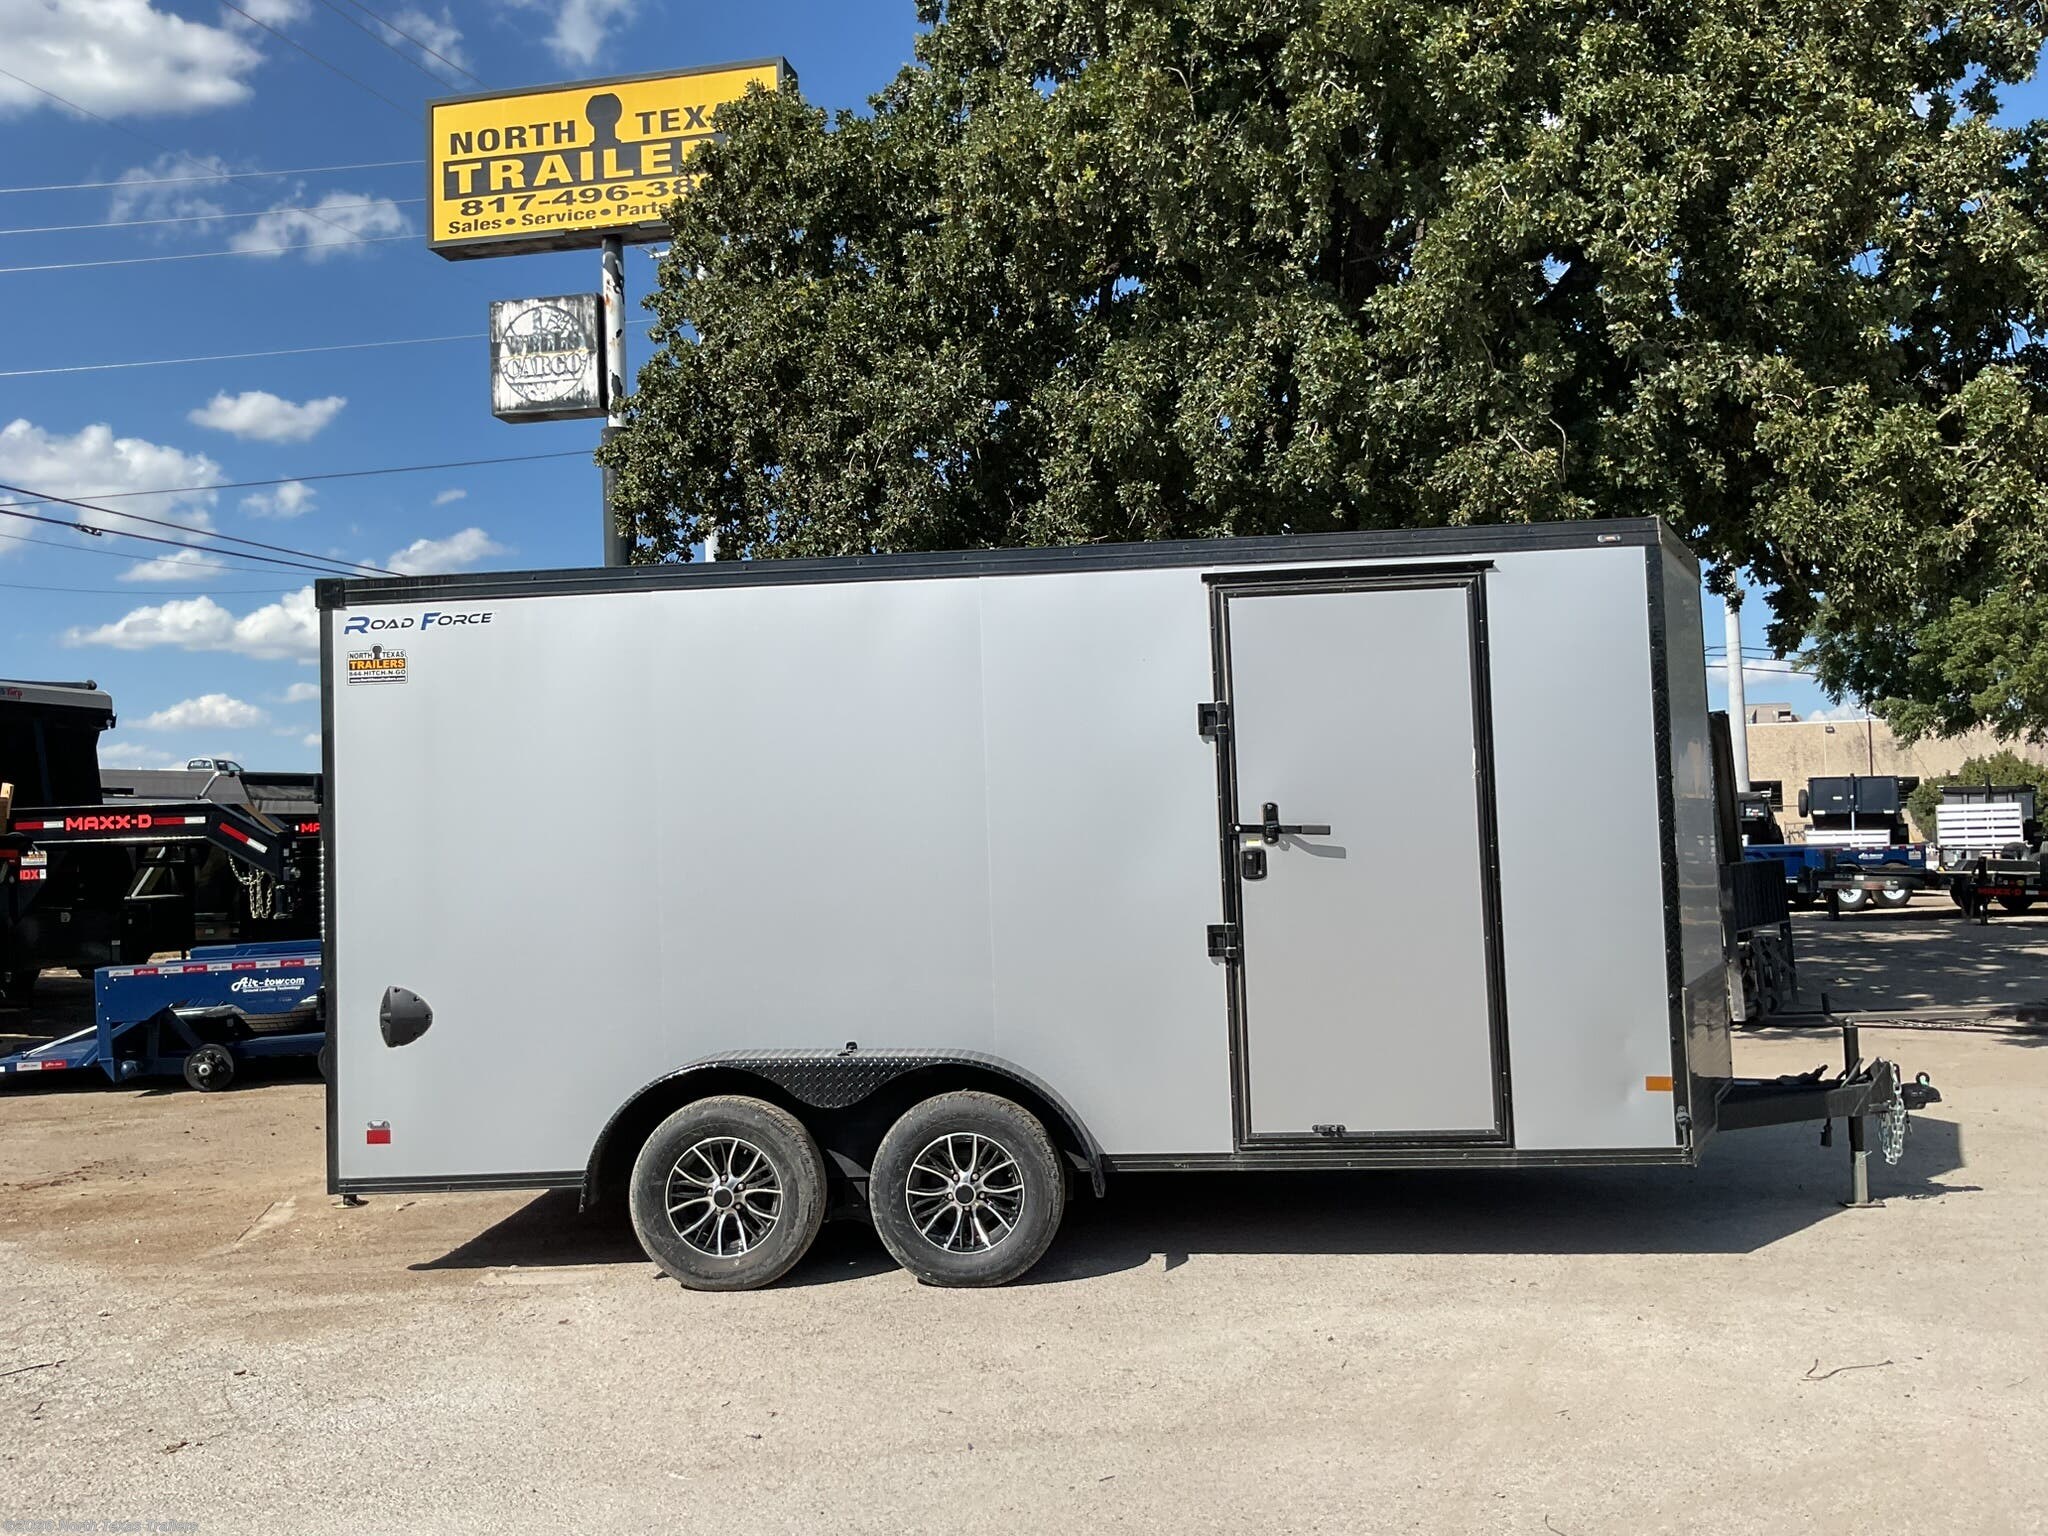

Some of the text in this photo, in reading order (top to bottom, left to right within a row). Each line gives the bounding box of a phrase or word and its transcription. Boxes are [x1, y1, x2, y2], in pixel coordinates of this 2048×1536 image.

[450, 120, 576, 155] NORTH
[448, 201, 669, 234] Sales Service Parts
[506, 353, 583, 379] CARGO
[349, 650, 405, 660] NORTH TEXAS
[350, 659, 405, 670] TRAILERS
[65, 814, 152, 831] MAXX-D
